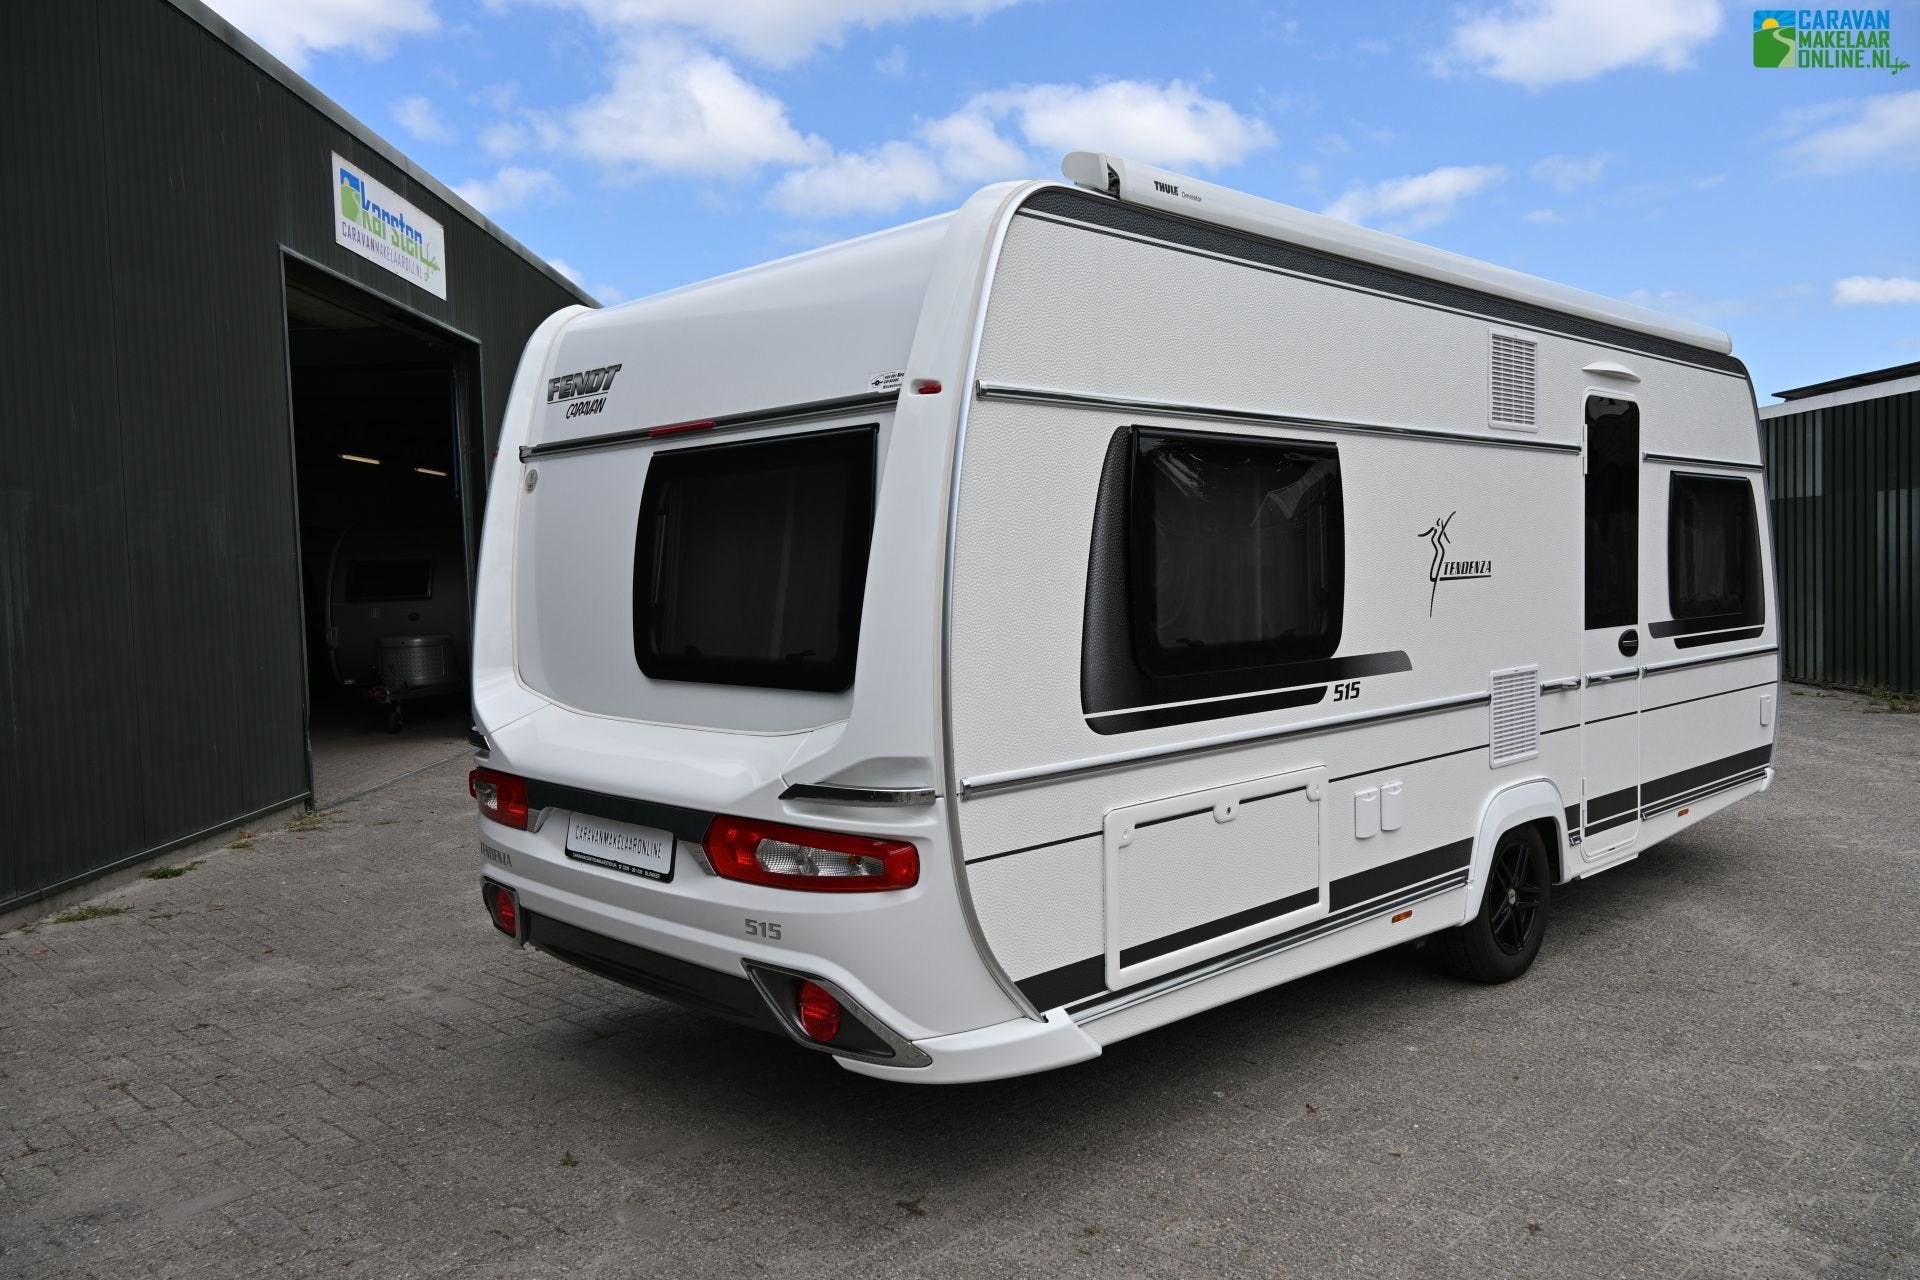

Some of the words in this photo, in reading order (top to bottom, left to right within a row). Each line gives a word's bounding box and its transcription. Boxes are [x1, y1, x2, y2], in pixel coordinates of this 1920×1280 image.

[1154, 181, 1179, 196] THULE
[342, 221, 423, 280] CARAVANMAKELAARDIJ.NL
[547, 364, 622, 402] FENDT
[566, 397, 607, 419] CARAVAN
[1444, 560, 1492, 576] TENDENZA
[1334, 681, 1360, 702] 515
[575, 823, 662, 858] CARAVANMAKELAARONLINE
[745, 918, 782, 940] 515
